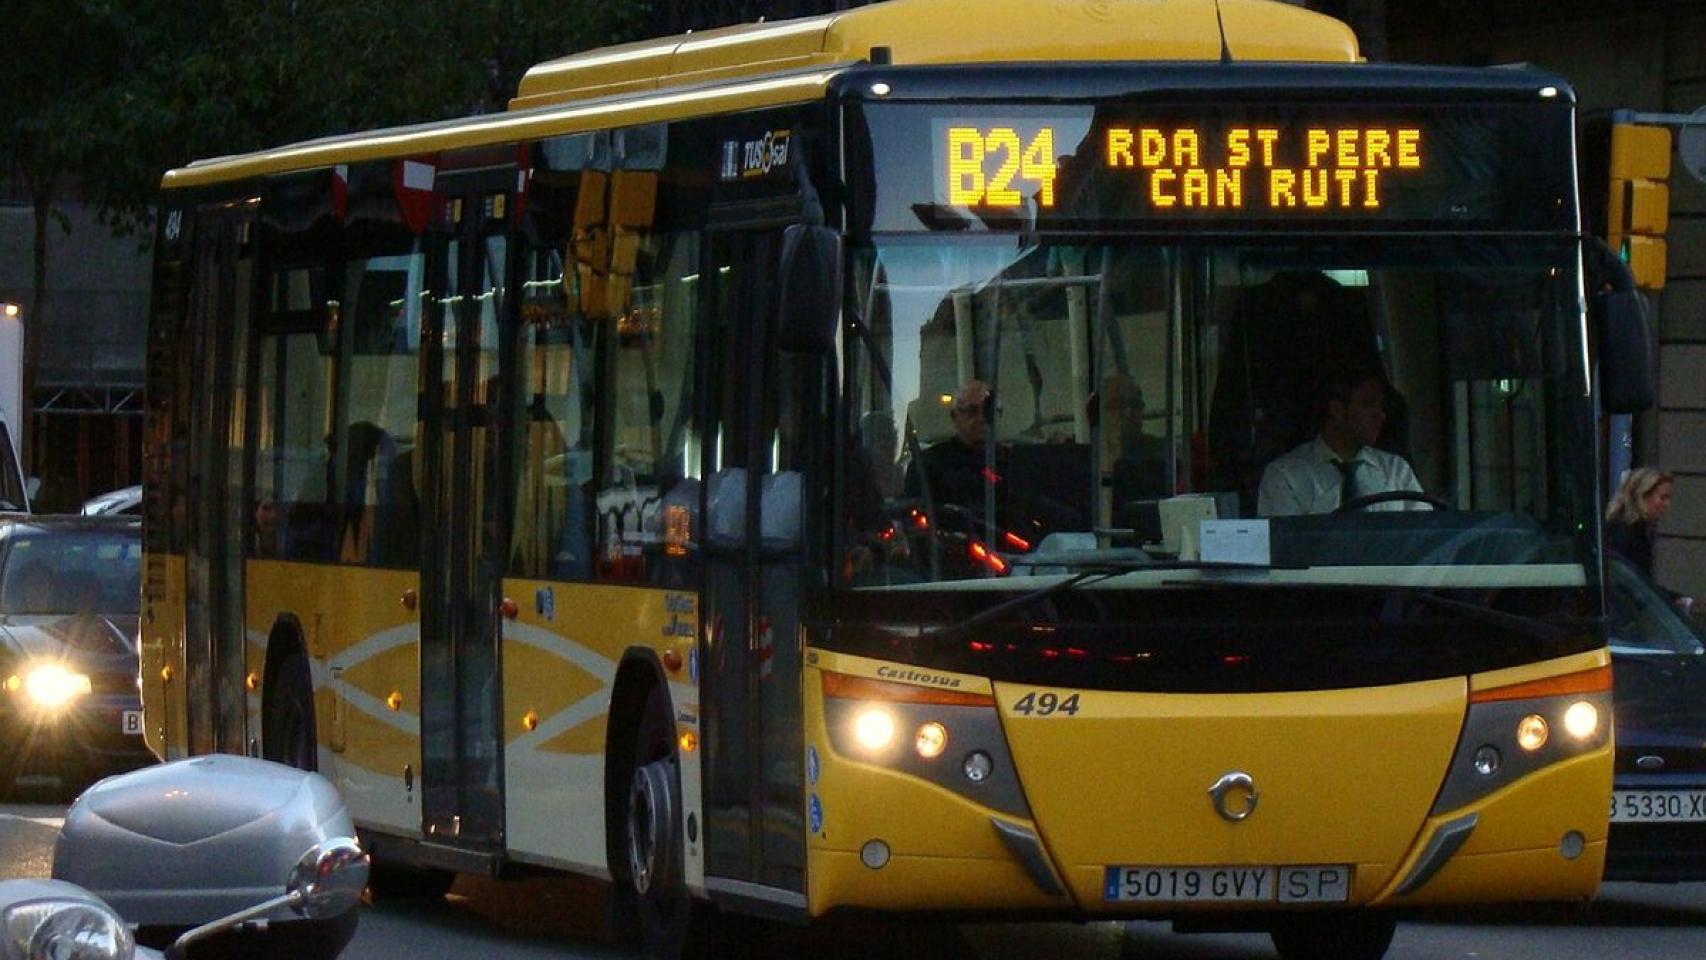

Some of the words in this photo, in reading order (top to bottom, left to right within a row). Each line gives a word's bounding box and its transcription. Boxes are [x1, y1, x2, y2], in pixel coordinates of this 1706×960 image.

[1106, 128, 1199, 167] RDA
[1227, 128, 1279, 167] ST
[1307, 128, 1421, 167] PERE
[948, 127, 1057, 206] B24
[1151, 168, 1242, 207] CAN
[1270, 168, 1380, 207] RUTI
[876, 665, 962, 688] Castrosua
[1013, 691, 1081, 716] 494
[127, 713, 139, 731] B
[1624, 794, 1681, 818] 5330
[1125, 870, 1201, 897] 5019
[1211, 870, 1266, 897] GVY
